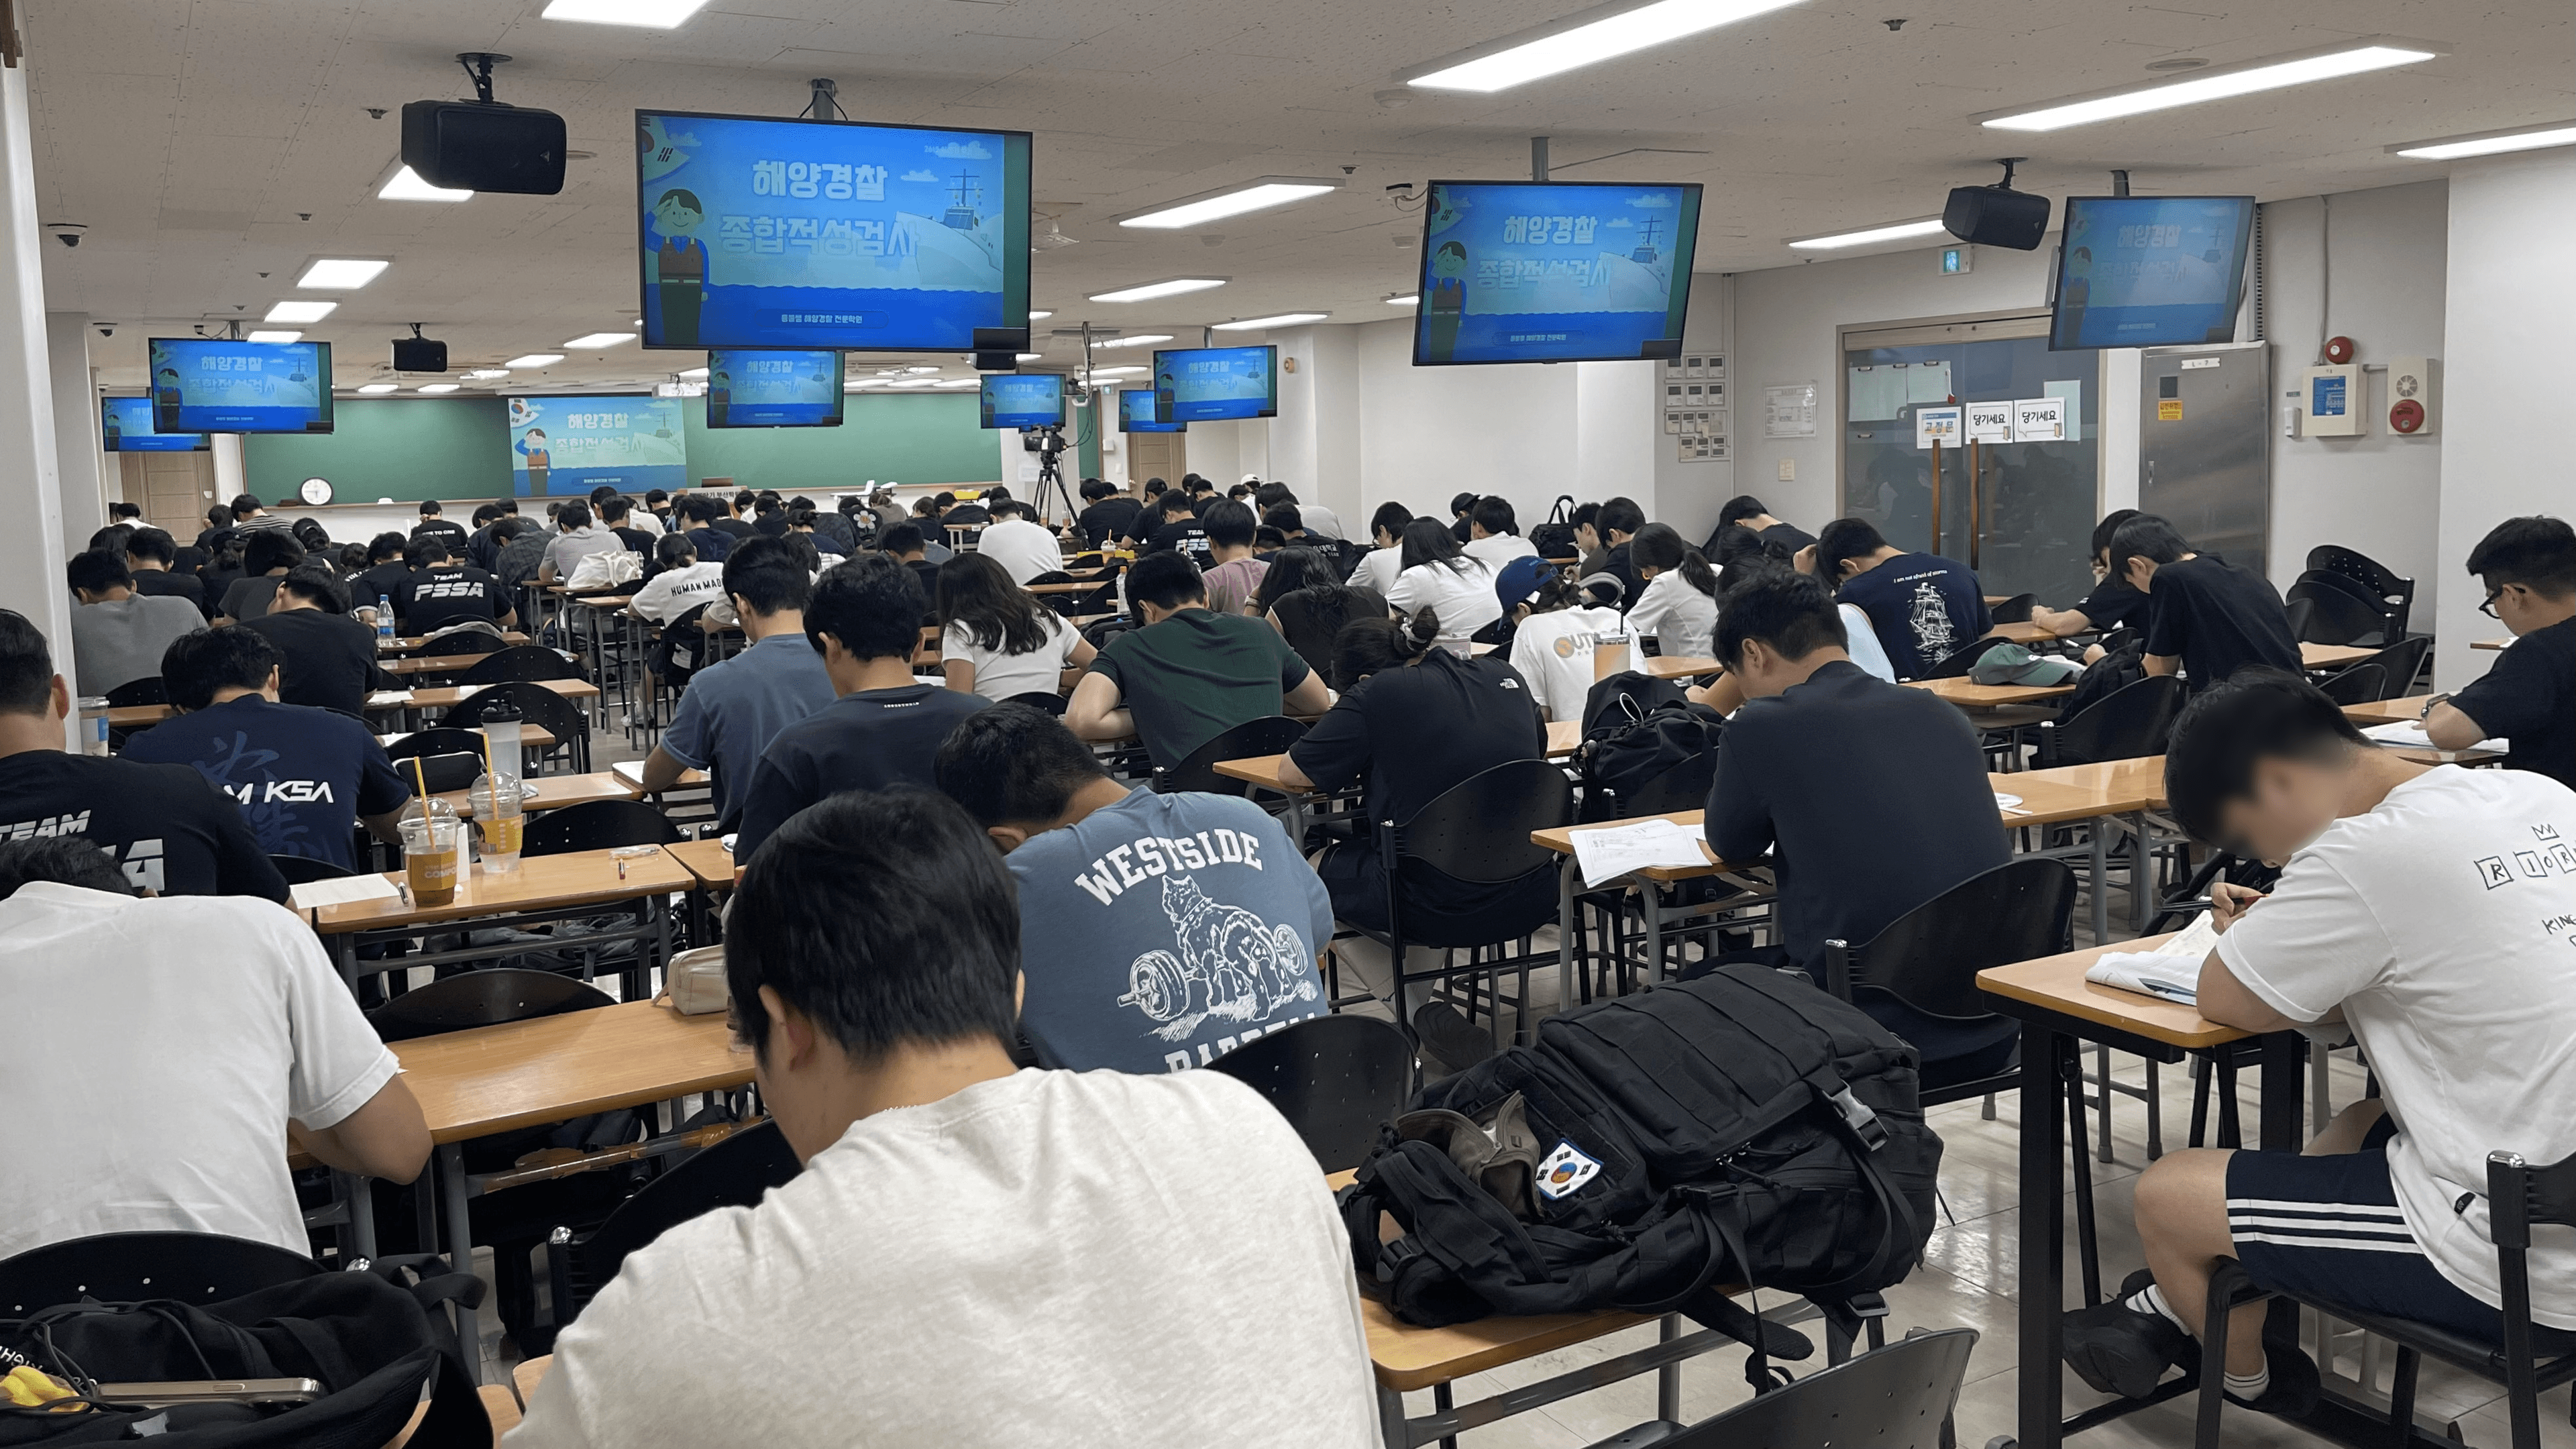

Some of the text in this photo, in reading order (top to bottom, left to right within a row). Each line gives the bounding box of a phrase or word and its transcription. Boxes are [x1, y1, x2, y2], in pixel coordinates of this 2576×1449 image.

[752, 159, 888, 201] 해양경찰
[720, 215, 918, 257] 종합적성검사
[1503, 215, 1598, 246] 해양경찰
[1973, 413, 2006, 426] 당기세요
[2022, 410, 2057, 424] 당기세요
[1175, 538, 1210, 553] PSS
[433, 572, 464, 581] TEAM
[415, 582, 484, 602] PSSA
[671, 578, 722, 597] HUMAN MAD
[1074, 828, 1263, 906] WESTSIDE
